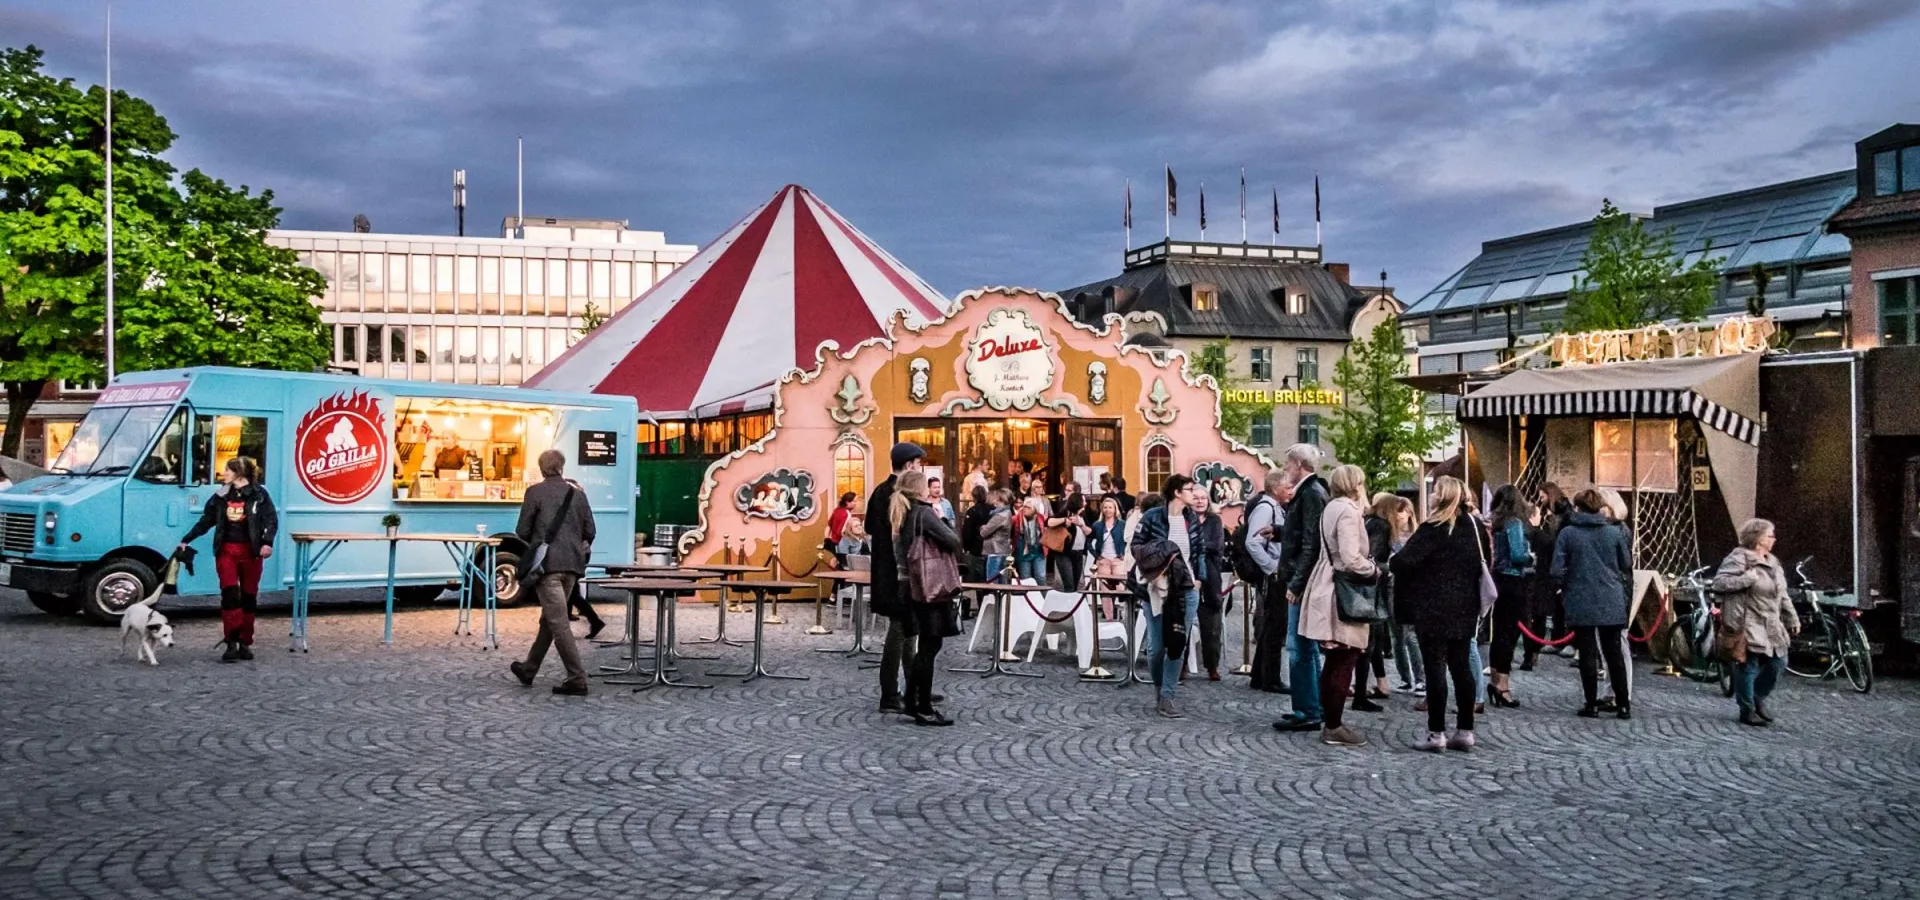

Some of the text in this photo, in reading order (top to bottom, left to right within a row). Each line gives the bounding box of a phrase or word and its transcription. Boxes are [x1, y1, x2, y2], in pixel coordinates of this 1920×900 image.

[978, 335, 1042, 361] Deluxe
[1226, 389, 1342, 404] HOTEL BREISETH
[306, 444, 377, 474] GO GRILLA
